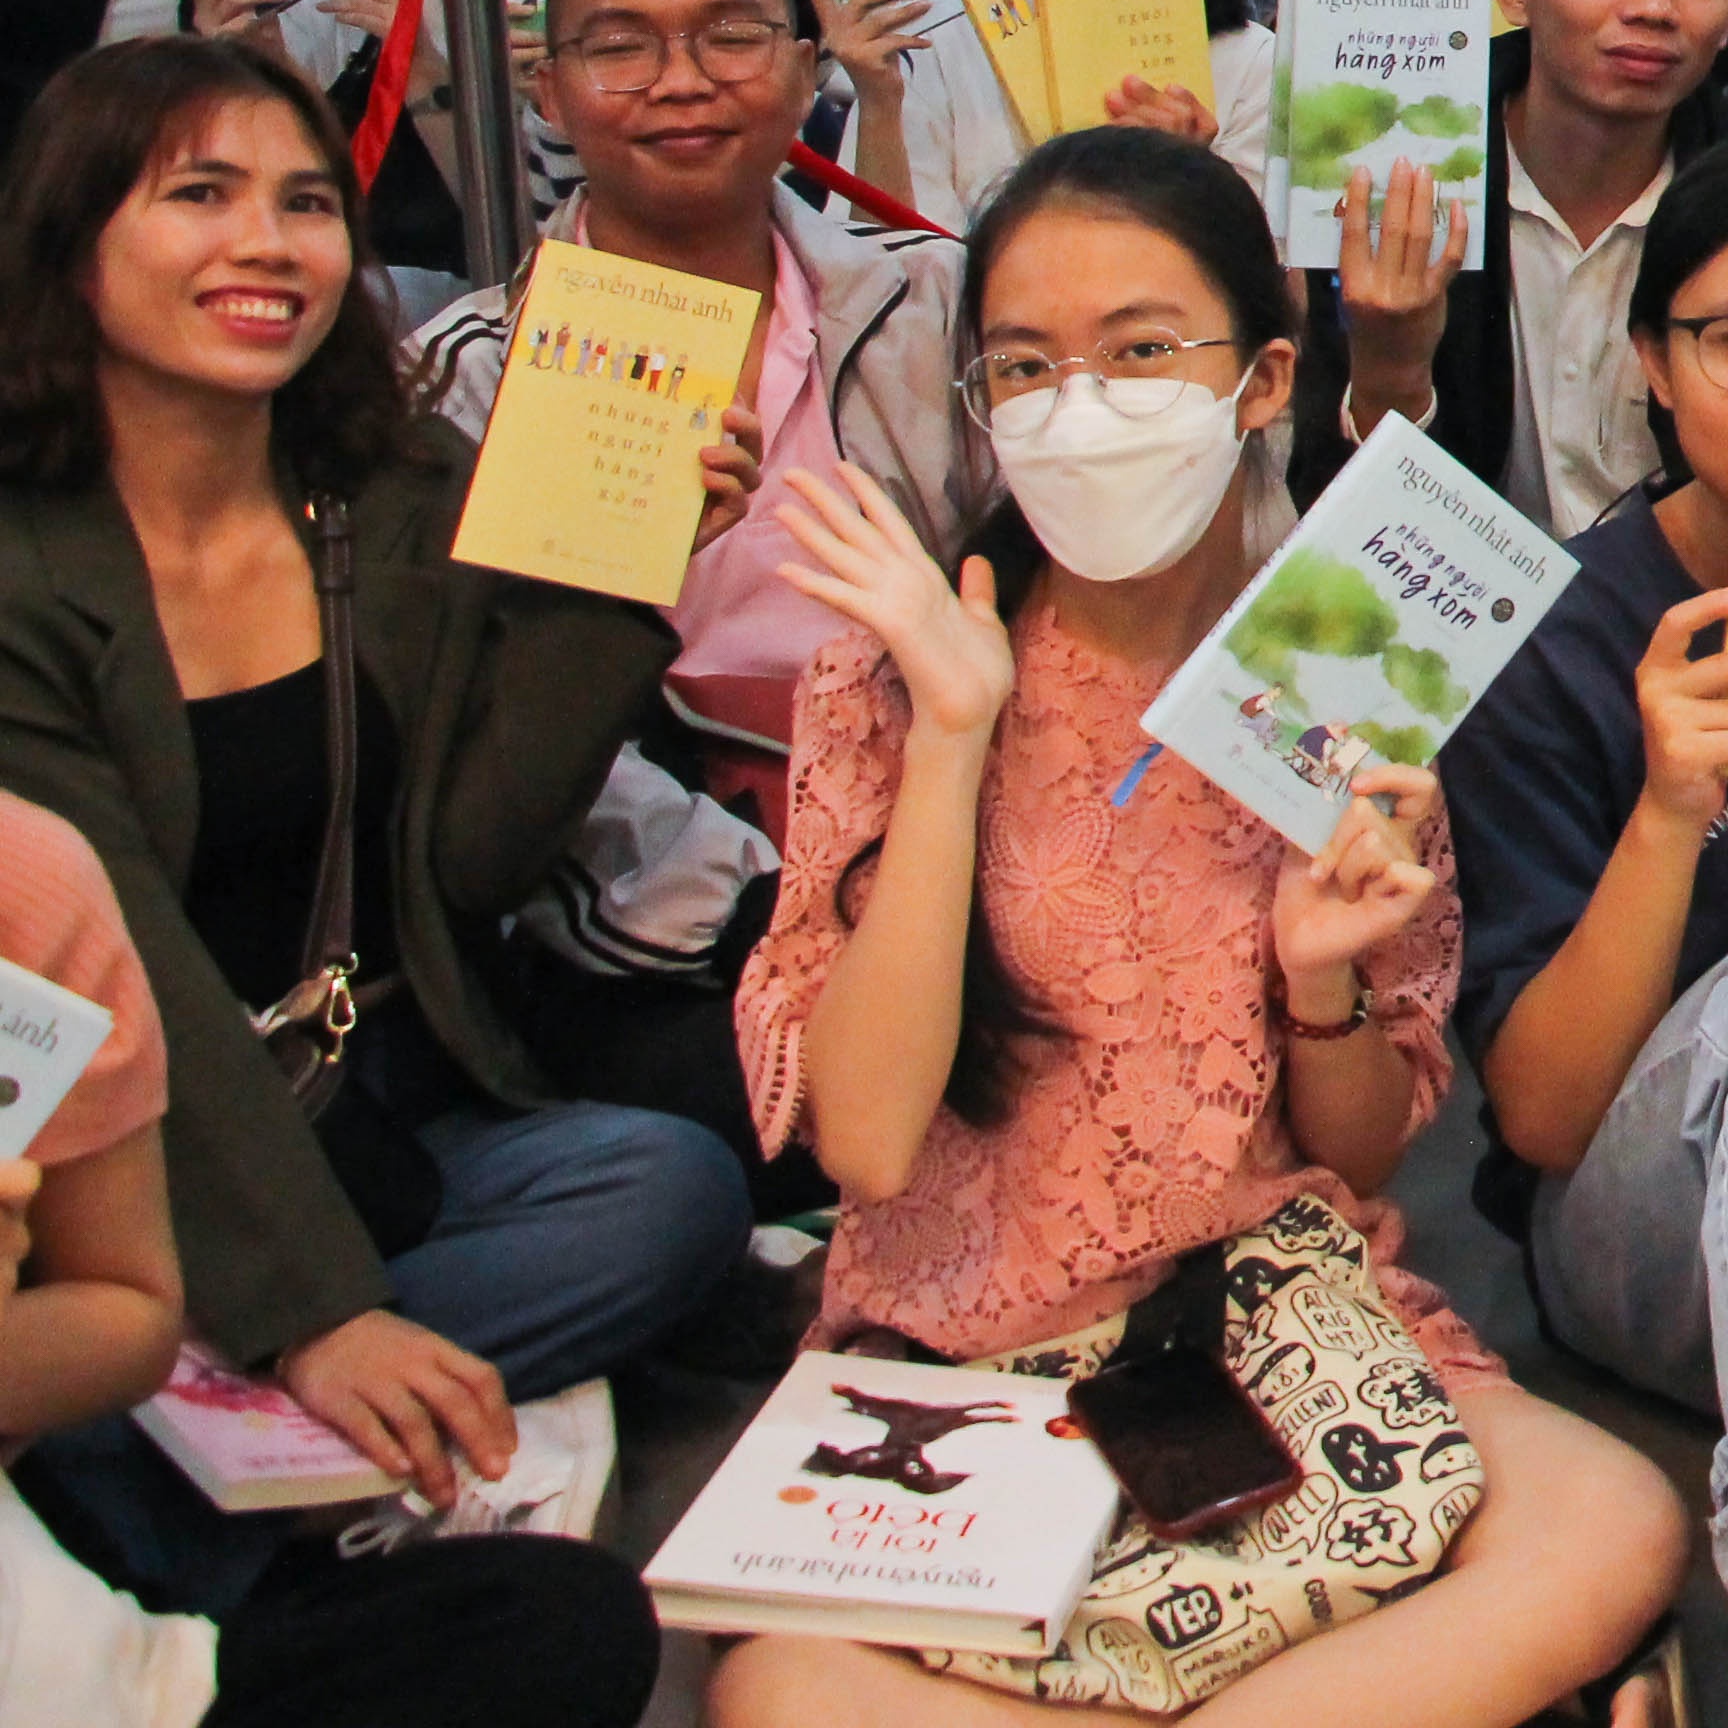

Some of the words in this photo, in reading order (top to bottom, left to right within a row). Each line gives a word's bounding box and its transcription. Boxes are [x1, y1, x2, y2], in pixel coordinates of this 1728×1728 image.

[1335, 42, 1397, 79] hàng
[1401, 49, 1446, 71] xóm
[1397, 456, 1470, 524] nguyễn
[1468, 513, 1512, 558] nhật
[1509, 544, 1546, 585] ánh
[1361, 525, 1431, 599] hàng
[1427, 586, 1478, 630] xóm
